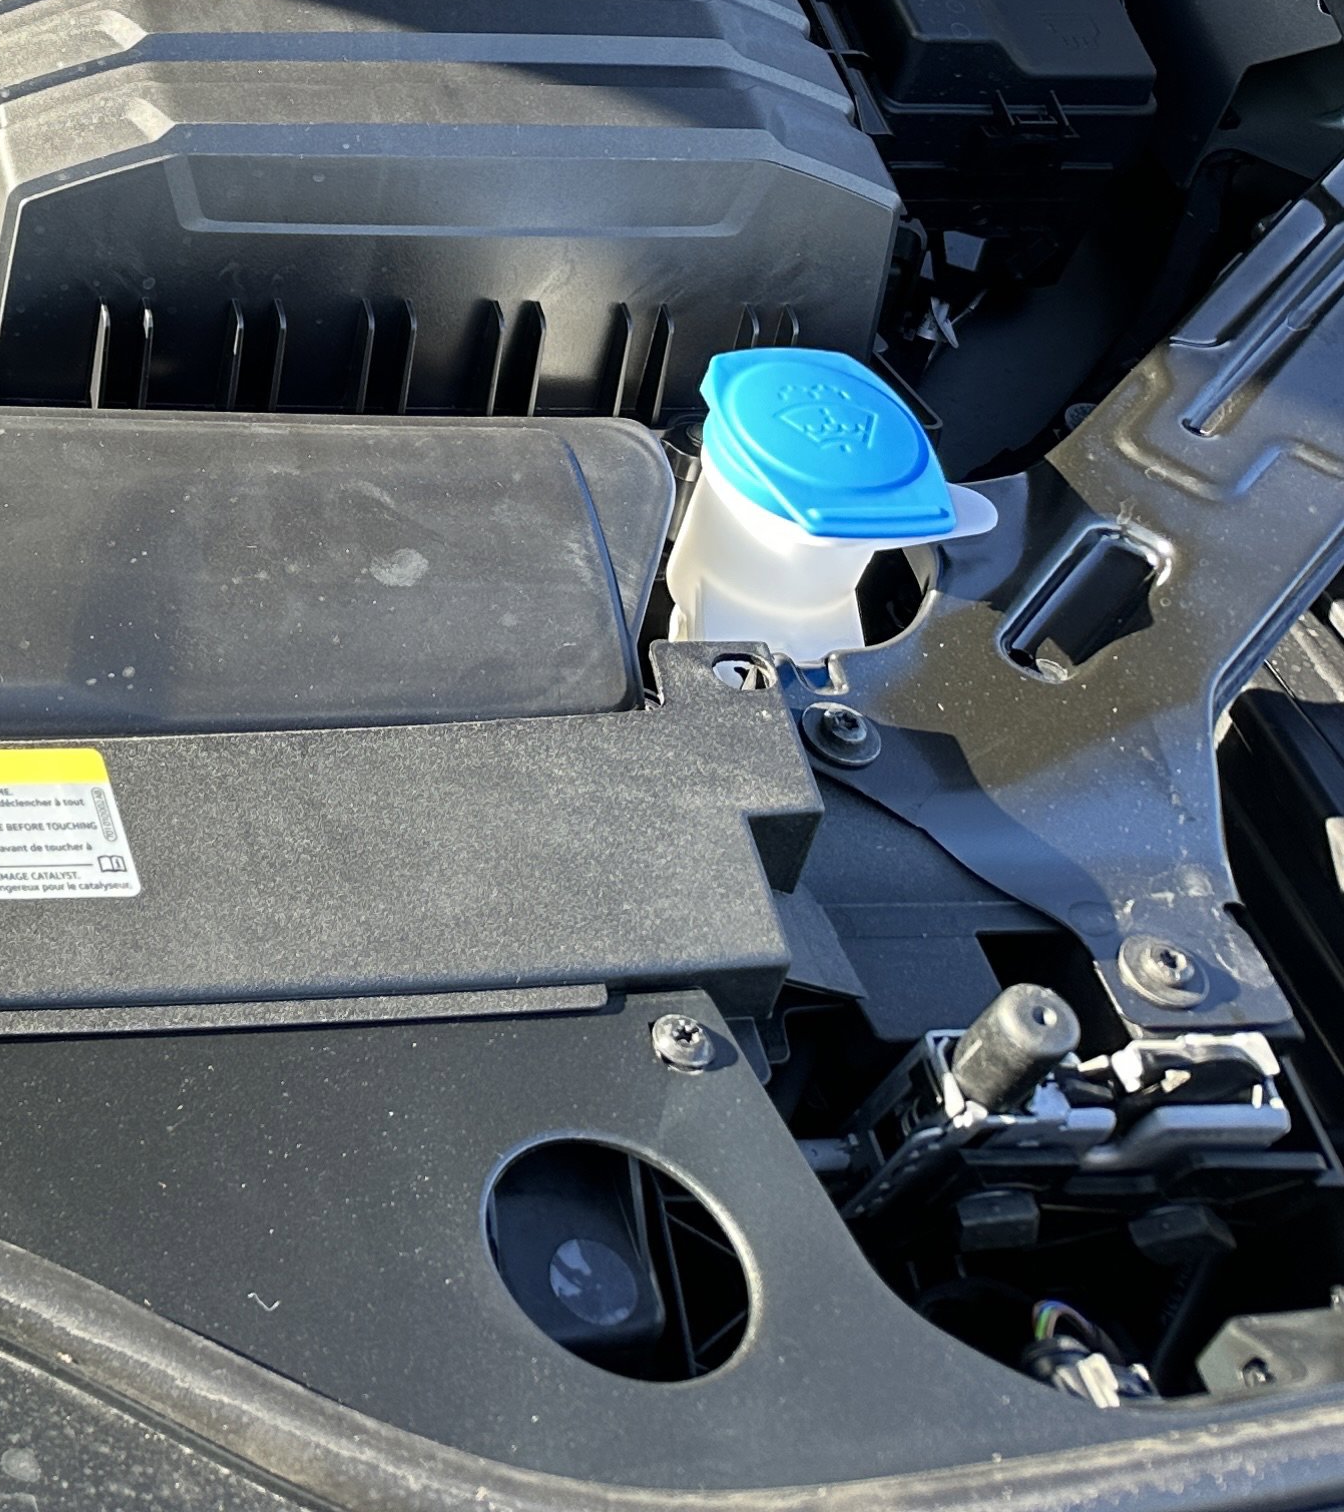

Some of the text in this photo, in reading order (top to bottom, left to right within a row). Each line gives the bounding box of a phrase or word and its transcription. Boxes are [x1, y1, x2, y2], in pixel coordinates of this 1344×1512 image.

[63, 798, 85, 807] tout
[5, 823, 44, 831] BEFORE
[46, 822, 98, 831] TOUCHING
[0, 844, 28, 853] avant
[30, 843, 43, 852] de
[44, 843, 84, 852] toucher
[42, 884, 64, 893] pour
[67, 882, 76, 891] le
